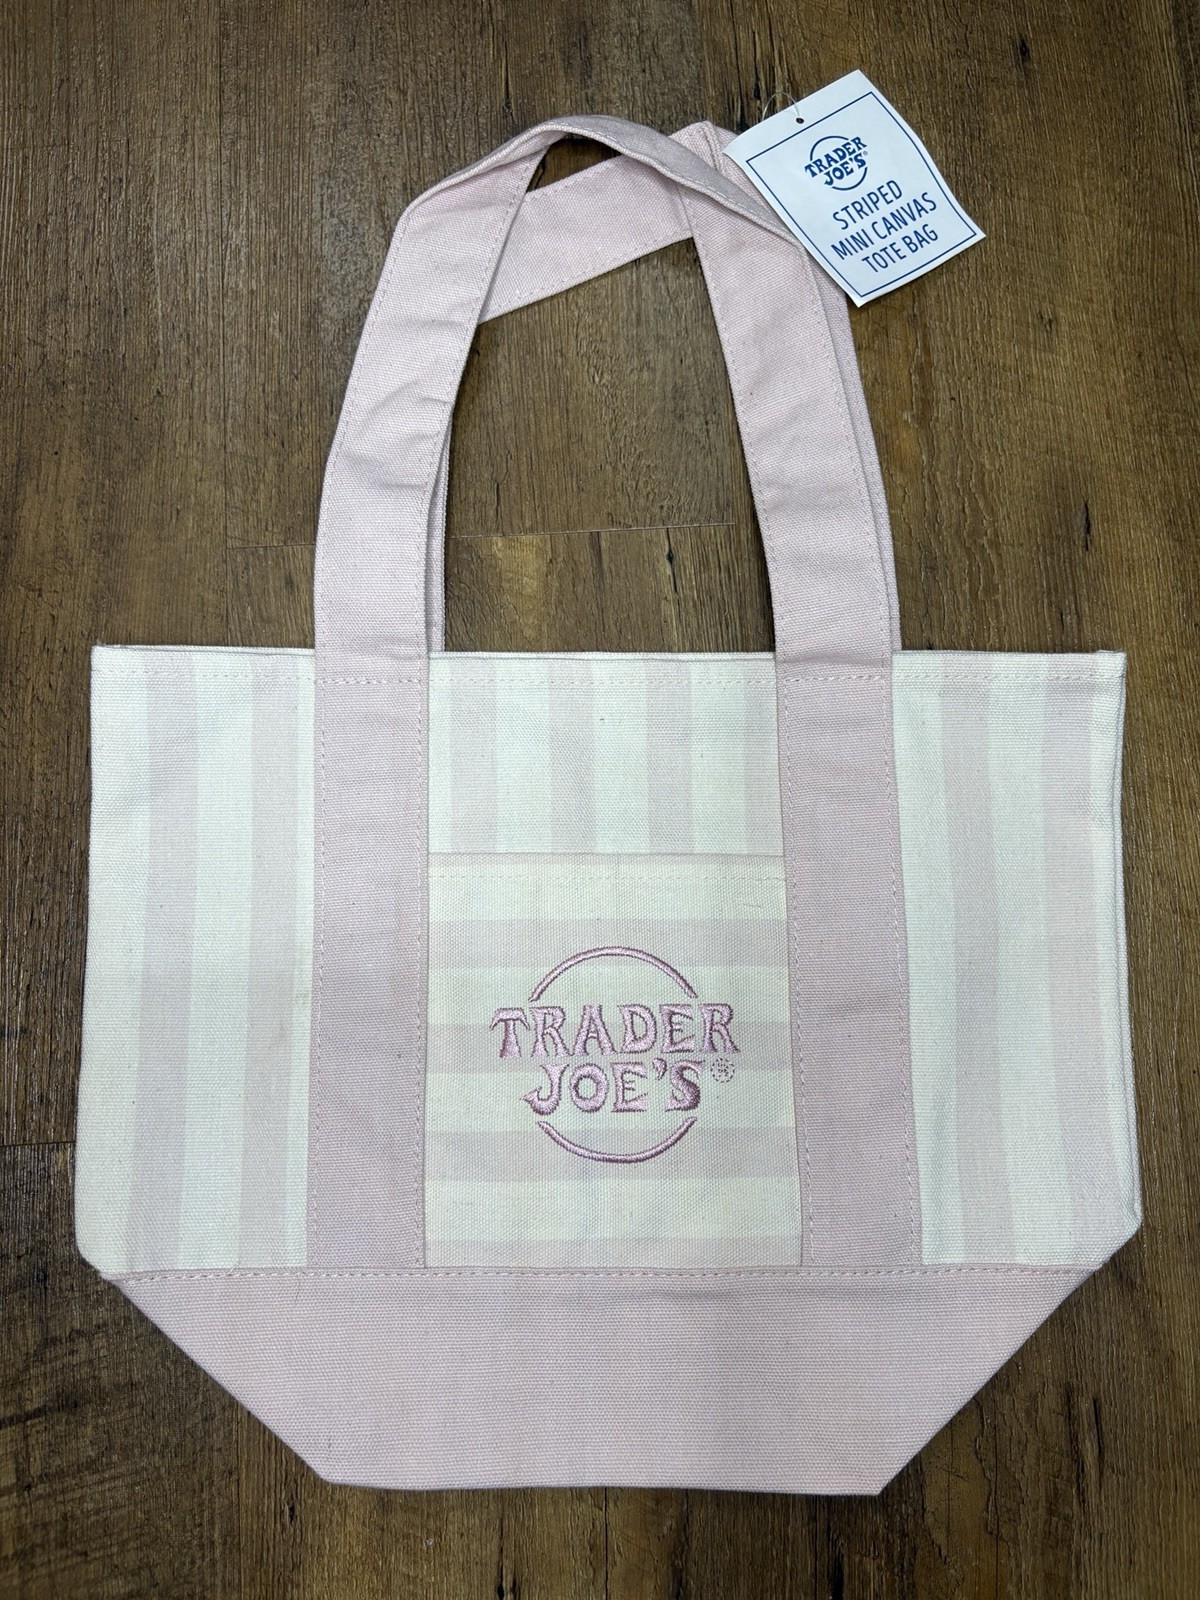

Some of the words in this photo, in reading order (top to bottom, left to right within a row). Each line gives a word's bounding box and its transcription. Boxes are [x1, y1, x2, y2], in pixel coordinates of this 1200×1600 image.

[804, 136, 867, 178] TRADER
[824, 153, 867, 187] JOE'S
[831, 229, 874, 260] MINI
[872, 192, 937, 240] CANVAS
[833, 179, 903, 230] STRIPED
[862, 242, 906, 273] TOTE
[902, 224, 938, 253] BAG
[489, 1003, 741, 1058] TRADER
